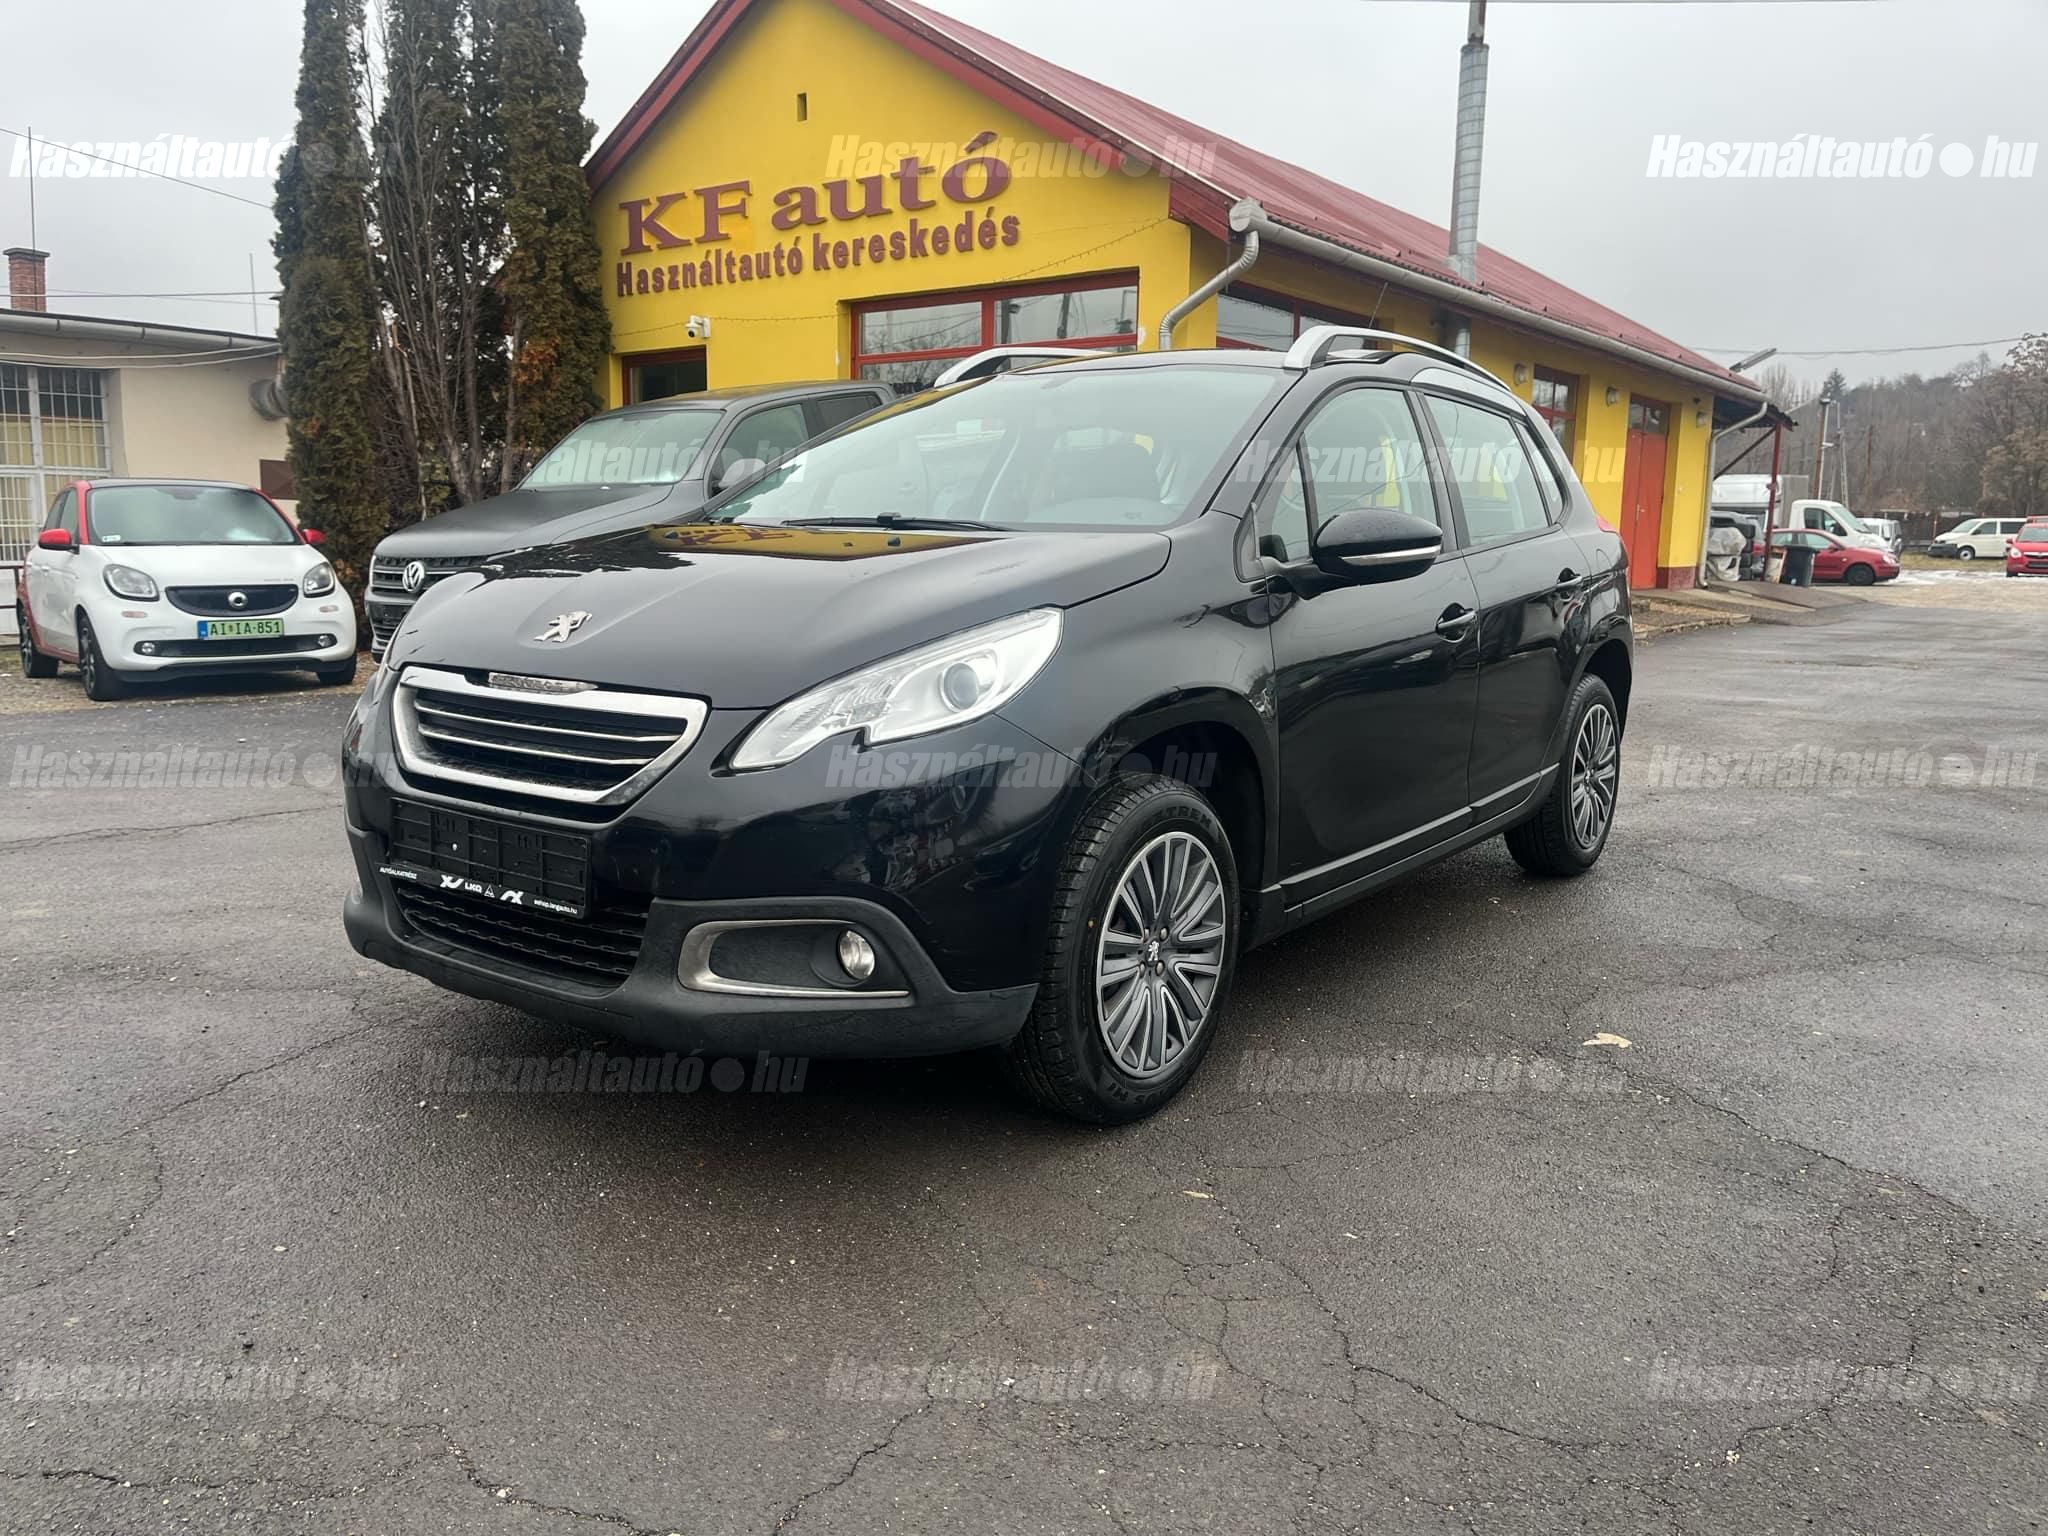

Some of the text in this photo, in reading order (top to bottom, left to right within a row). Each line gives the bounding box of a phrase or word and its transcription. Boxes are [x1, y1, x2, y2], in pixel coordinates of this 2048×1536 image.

[619, 131, 1012, 256] KF autó
[616, 205, 1020, 297] Használtautó kereskedés
